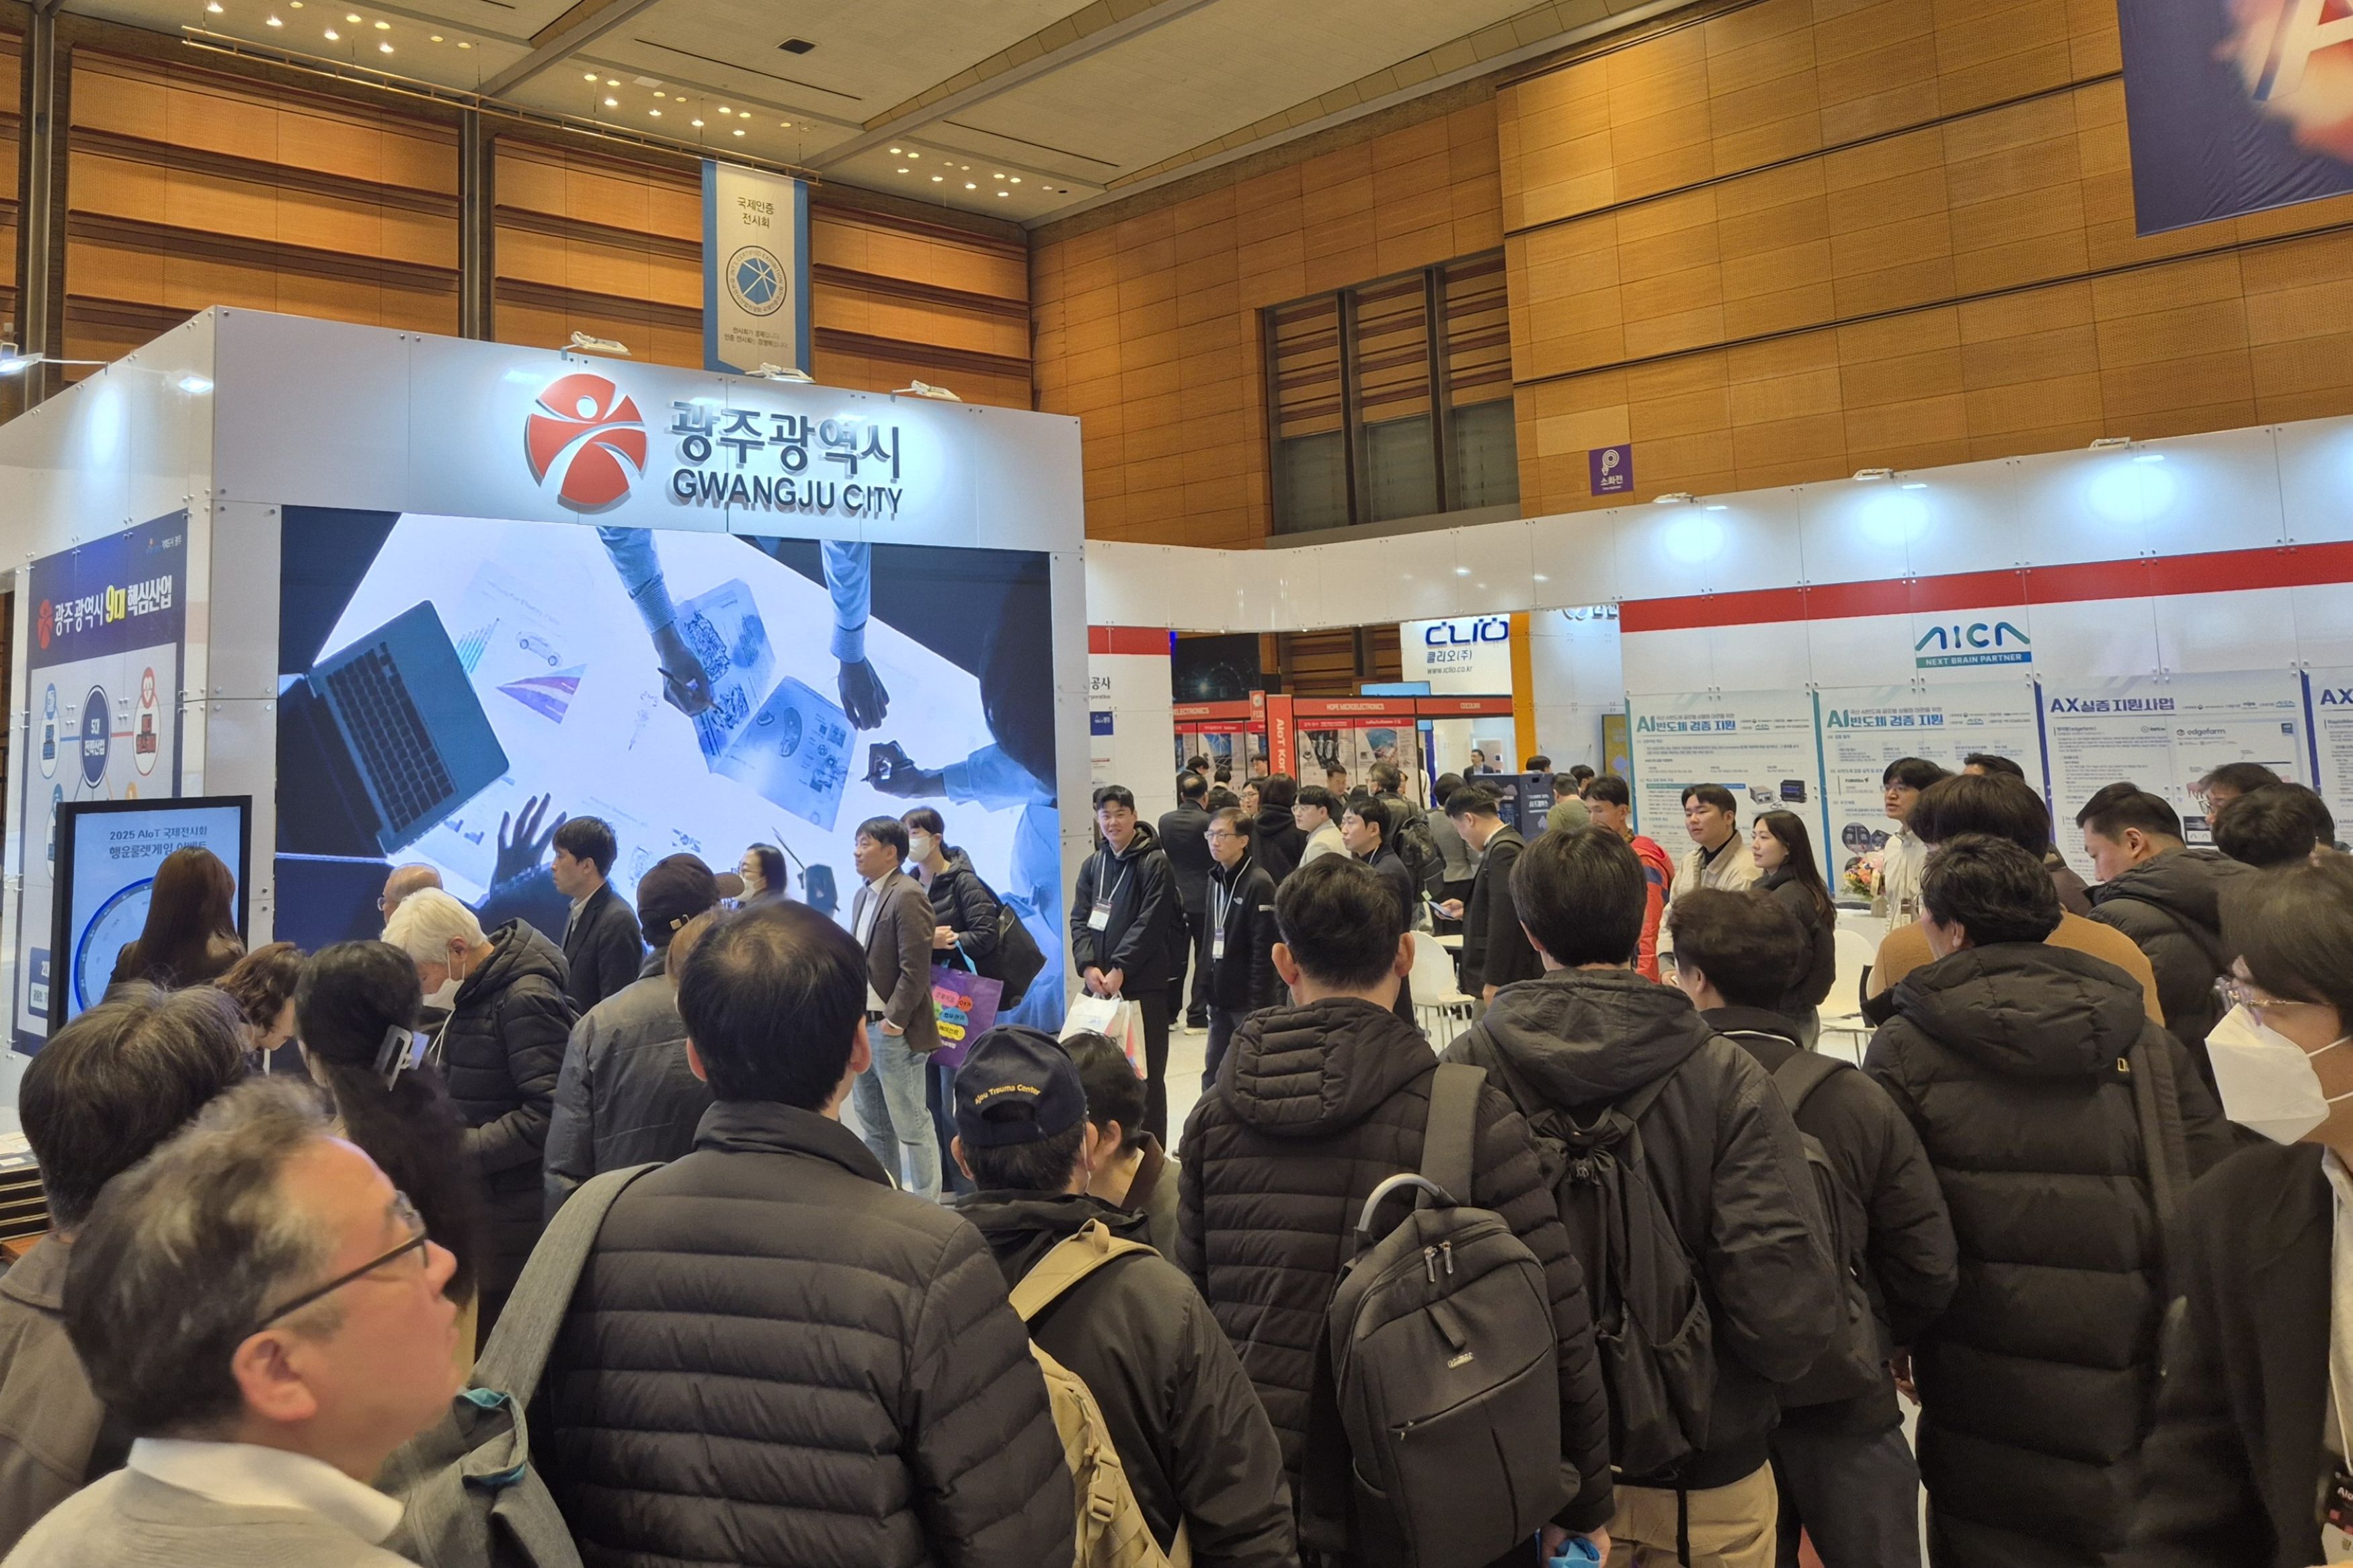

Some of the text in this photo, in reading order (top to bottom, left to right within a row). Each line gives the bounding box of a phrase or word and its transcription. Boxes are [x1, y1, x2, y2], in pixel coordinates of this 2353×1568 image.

[737, 196, 774, 215] 국제인증
[742, 213, 770, 229] 전시회
[672, 401, 900, 479] 광주광역시
[1600, 474, 1623, 486] 소화전
[673, 469, 902, 513] GWANGJU CITY
[54, 575, 172, 636] 광주광역시 9대 핵심산업
[1425, 618, 1509, 645] CLIO
[1427, 649, 1472, 663] 클리오(주)
[1925, 653, 2022, 666] NEXT BRAIN PARTNER
[1090, 676, 1111, 690] 공사
[2320, 688, 2353, 706] AX
[1636, 716, 1655, 733] AI
[1657, 721, 1688, 732] 반도체
[1689, 720, 1711, 731] 검증
[1714, 720, 1736, 731] 지원
[1827, 709, 1943, 728] AI 반도체 검증 지원
[1276, 718, 1286, 747] AIoT
[2187, 727, 2226, 737] edgefarm
[110, 826, 207, 840] 2025 AIoT 국제전시회
[109, 843, 173, 860] 행운룰렛게임
[974, 1083, 1041, 1106] Ajou Trauma Center
